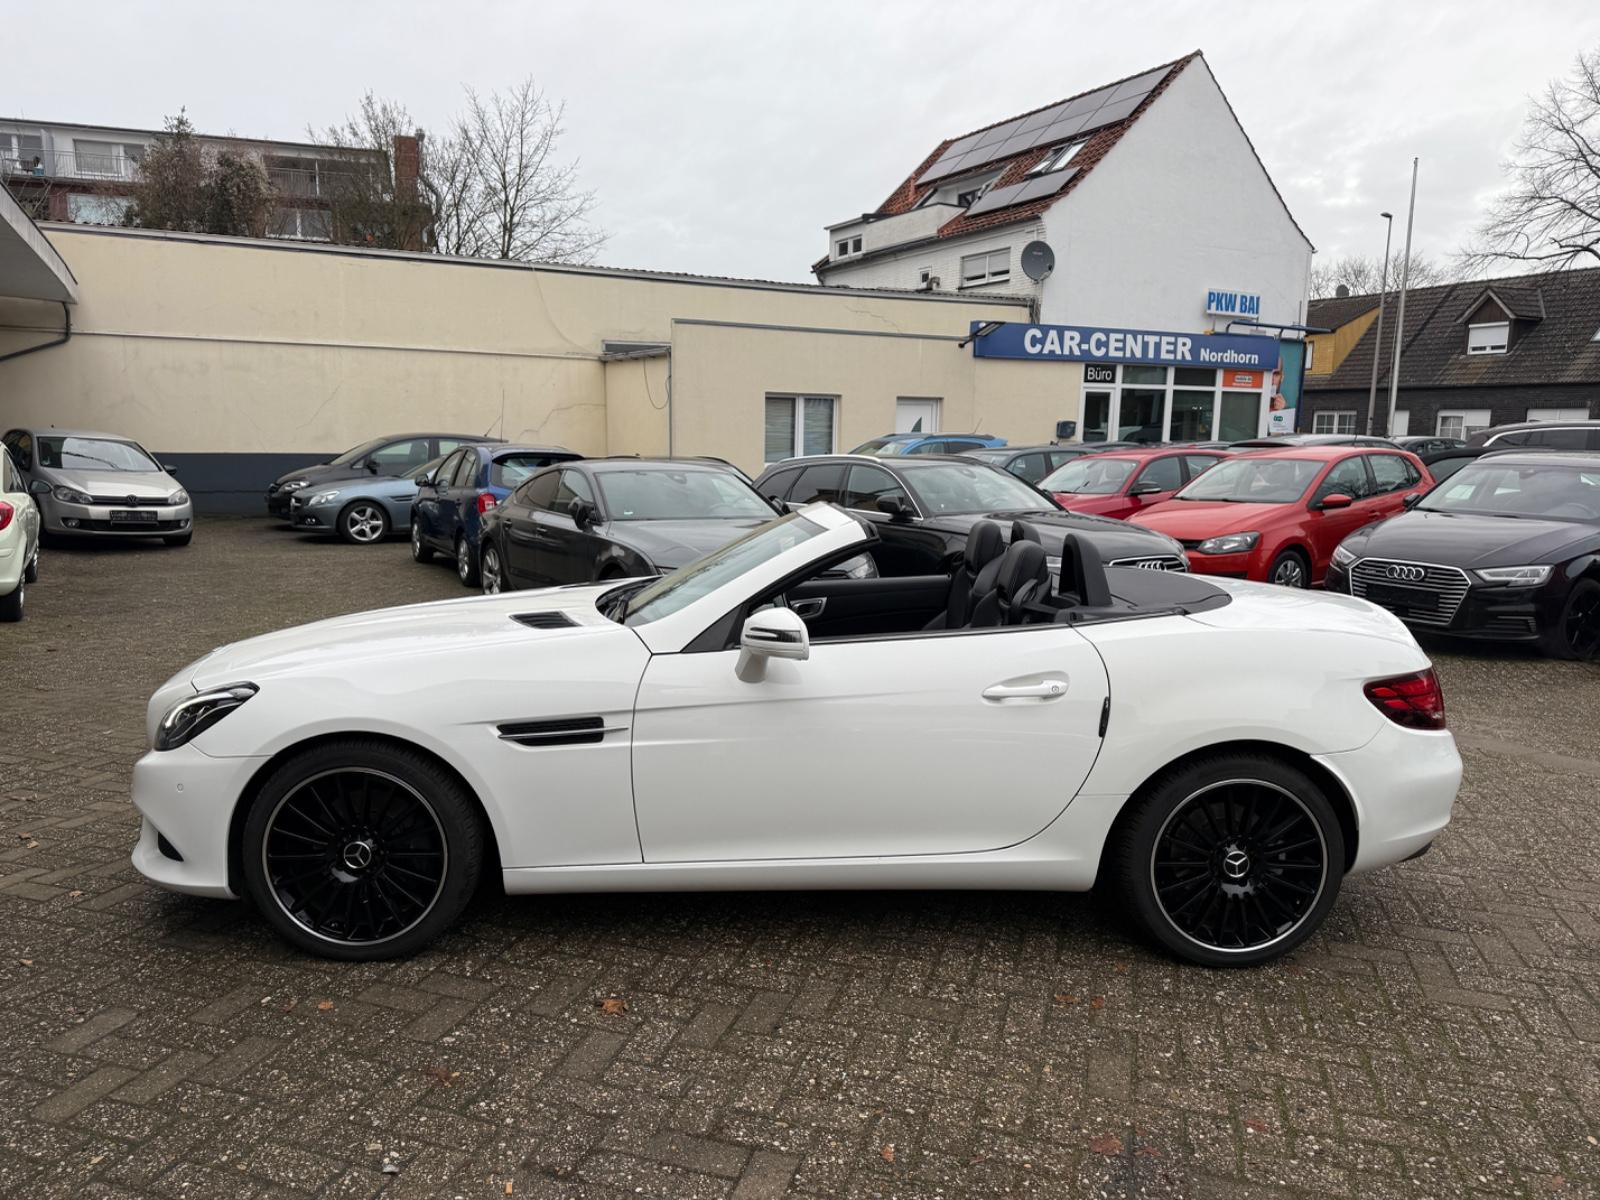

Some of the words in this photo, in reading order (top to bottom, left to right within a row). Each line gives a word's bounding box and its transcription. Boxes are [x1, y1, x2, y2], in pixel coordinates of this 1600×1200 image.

[1207, 291, 1237, 312] PKW
[1023, 327, 1192, 361] CAR-CENTER
[1200, 347, 1259, 365] Nordhorn
[1087, 366, 1113, 381] Büro
